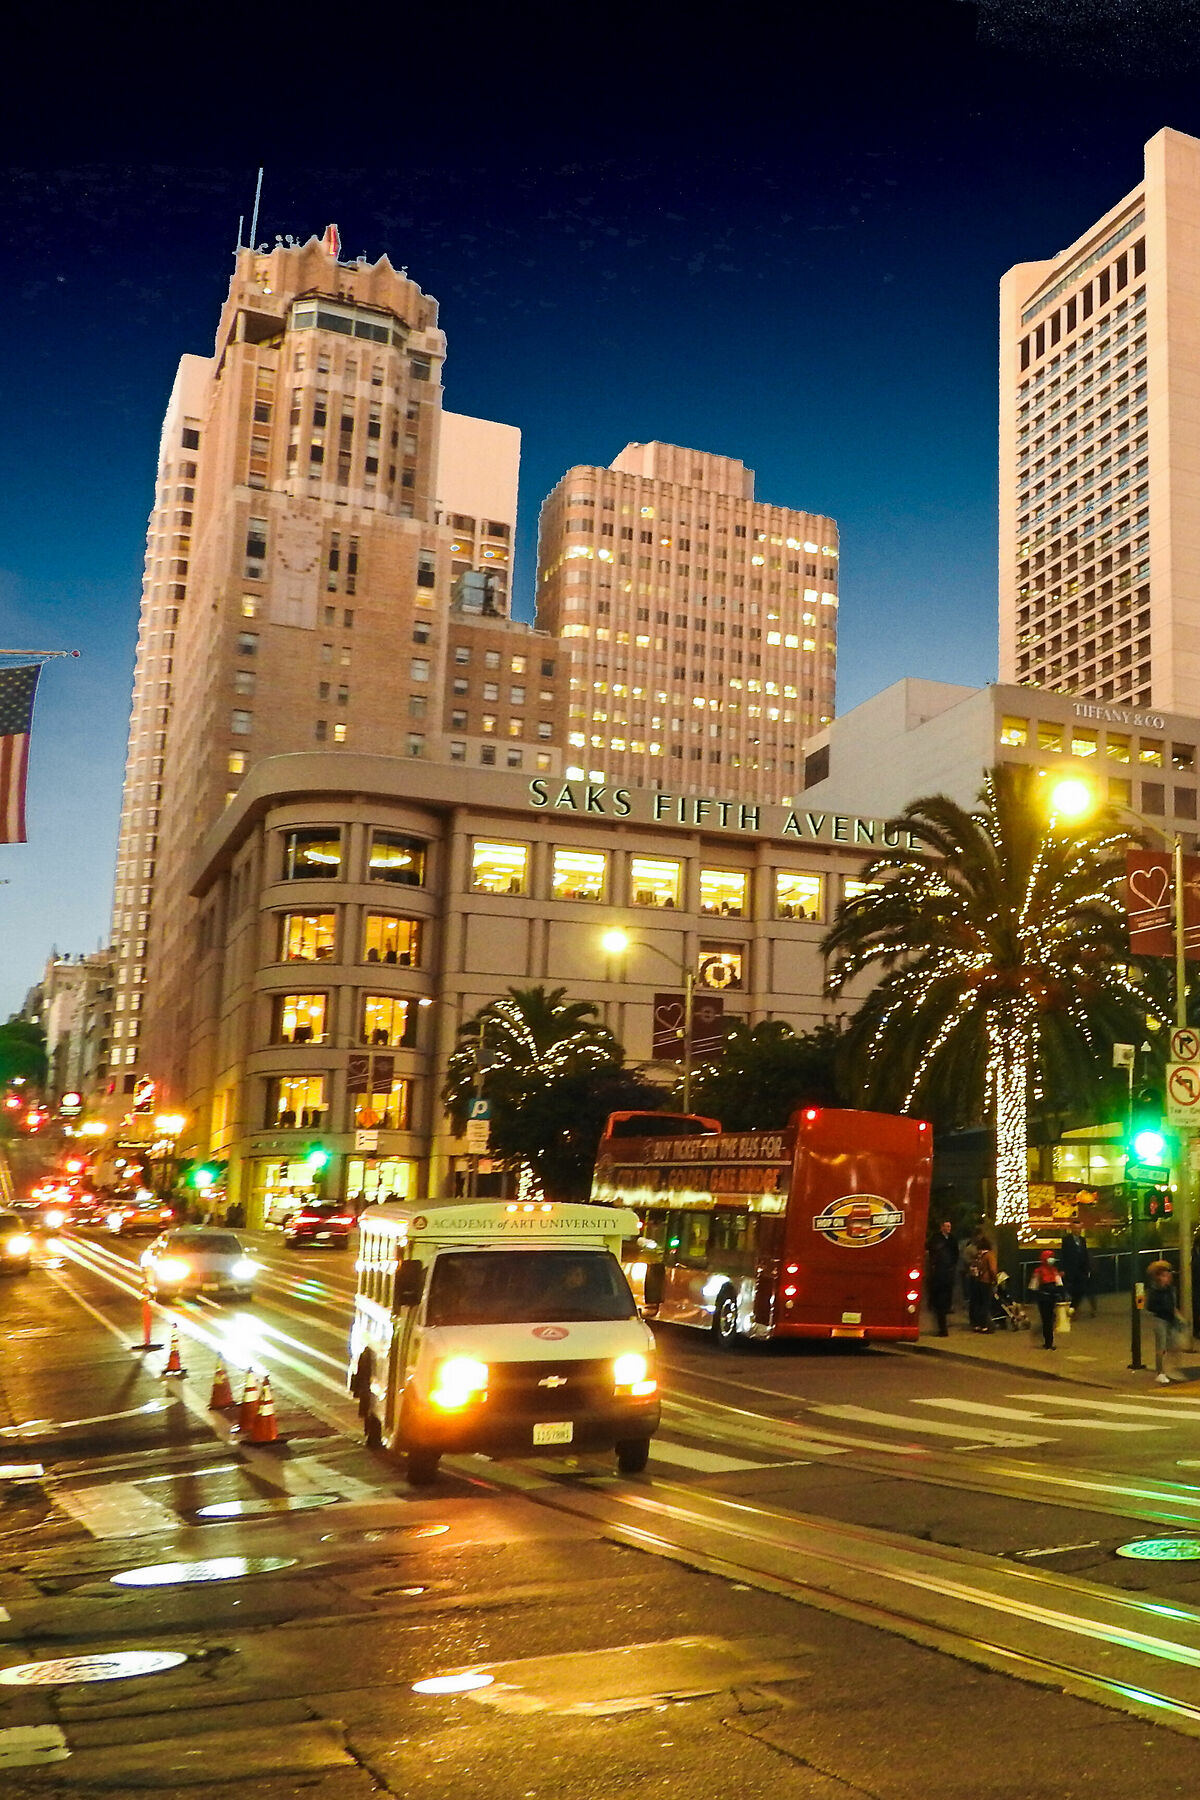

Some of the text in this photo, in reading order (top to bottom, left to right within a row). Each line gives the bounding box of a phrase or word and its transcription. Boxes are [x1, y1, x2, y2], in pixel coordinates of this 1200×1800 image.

[1073, 703, 1131, 724] TIFFANY
[529, 778, 923, 851] SAKS FIFTH AVENUE
[655, 1141, 673, 1160] BUY
[701, 1139, 718, 1159] ON
[719, 1137, 738, 1159] THE
[739, 1137, 758, 1158] BUS
[760, 1136, 783, 1158] FOR
[710, 1168, 736, 1191] GATE
[432, 1218, 619, 1230] ACADEMY of ART UNIVERSITY
